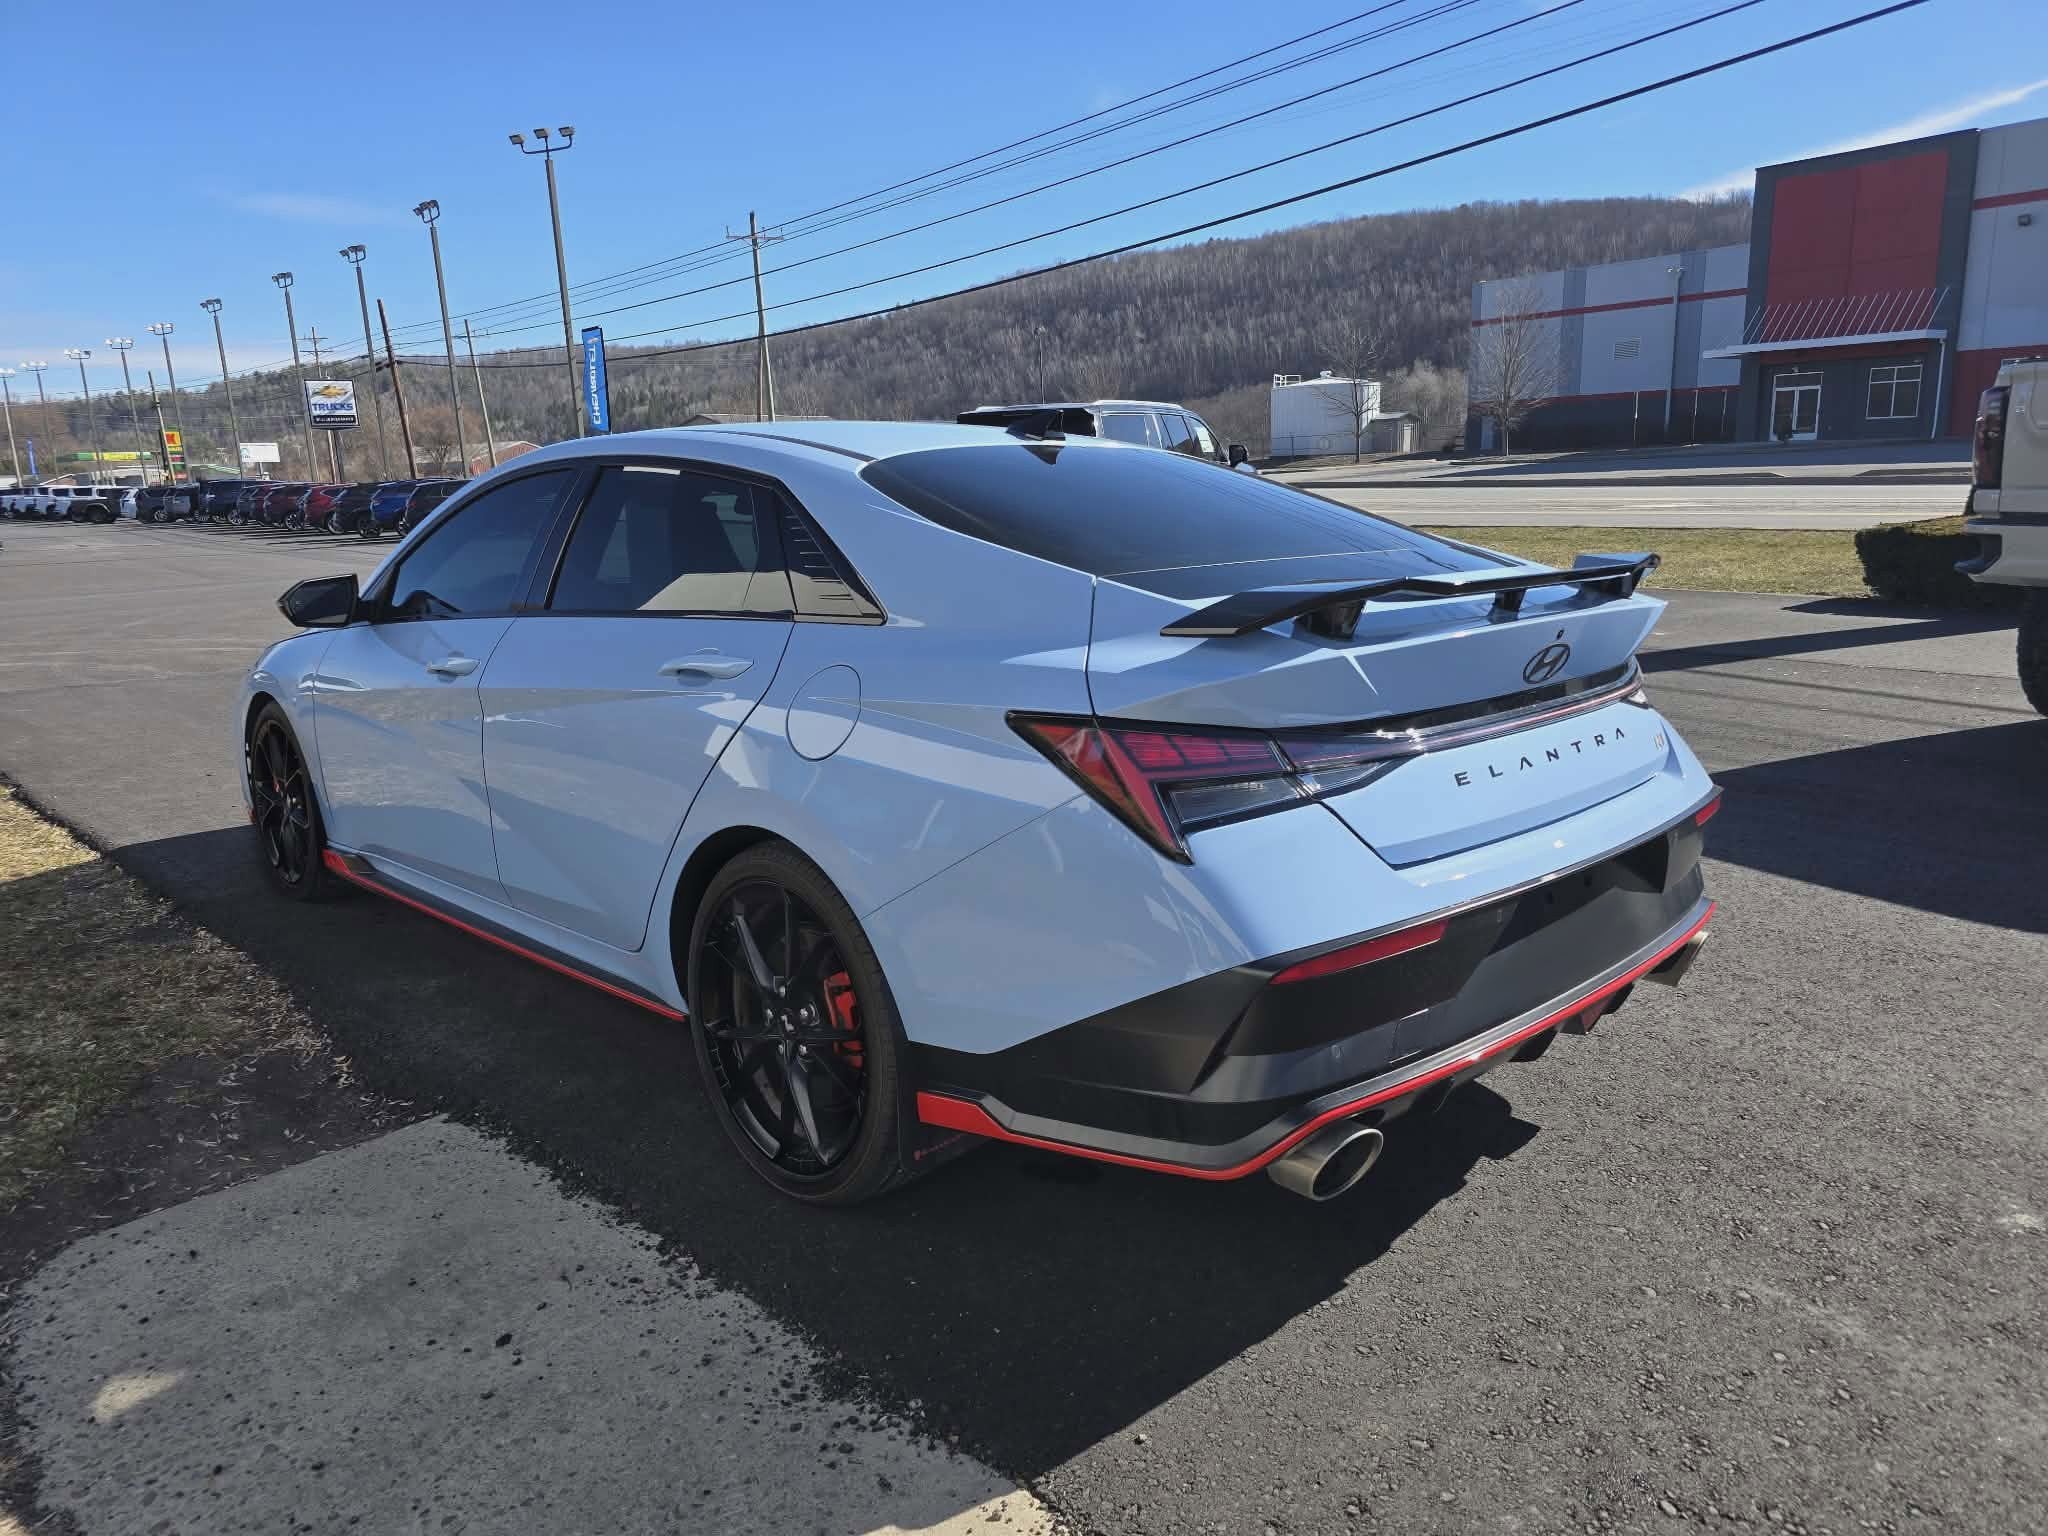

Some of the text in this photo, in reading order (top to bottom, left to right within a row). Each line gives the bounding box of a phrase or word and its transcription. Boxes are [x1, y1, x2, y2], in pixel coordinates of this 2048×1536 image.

[311, 402, 353, 411] TRUCKS
[588, 344, 602, 425] CHEVROLET
[1454, 727, 1626, 787] ELANTRA
